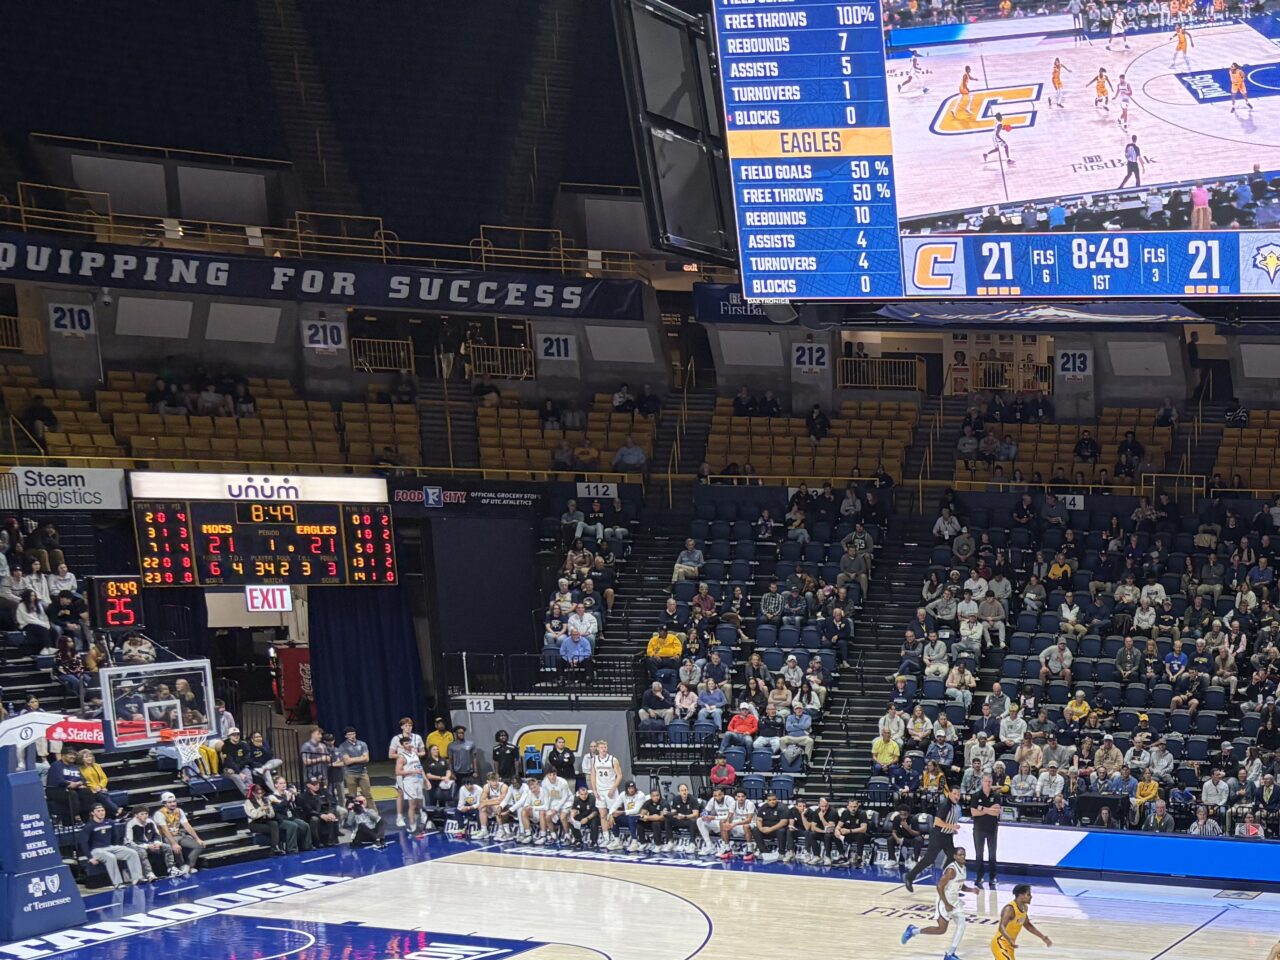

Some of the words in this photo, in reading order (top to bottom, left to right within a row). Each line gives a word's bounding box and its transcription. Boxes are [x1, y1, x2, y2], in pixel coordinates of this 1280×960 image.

[725, 14, 755, 29] FREE
[757, 11, 807, 28] THROWS
[836, 6, 874, 25] 100%
[727, 37, 790, 53] REBOUNDS
[838, 33, 848, 51] 7
[730, 62, 779, 77] ASSISTS
[841, 57, 851, 75] 5
[732, 86, 800, 101] TURNOVERS
[843, 81, 850, 100] 1
[735, 110, 780, 125] BLOCKS
[846, 107, 856, 125] 0
[780, 131, 842, 153] EAGLES
[740, 165, 773, 180] FIELD
[775, 165, 812, 179] GOALS
[743, 189, 772, 203] FREE
[773, 188, 823, 202] THROWS
[745, 211, 807, 226] REBOUNDS
[854, 206, 870, 224] 10
[748, 235, 795, 249] ASSISTS
[857, 231, 867, 248] 4
[750, 257, 817, 271] TURNOVERS
[858, 252, 869, 269] 4
[982, 242, 1014, 281] 21
[1033, 250, 1054, 265] FLS
[1071, 238, 1129, 269] 8:49
[1144, 247, 1165, 263] FLS
[1188, 240, 1220, 279] 21
[1042, 269, 1050, 283] 6
[1092, 275, 1110, 290] 1ST
[1152, 268, 1160, 282] 3
[271, 267, 356, 295] FOR
[388, 275, 583, 309] SUCCESS
[753, 279, 796, 293] BLOCKS
[861, 276, 871, 293] 0
[53, 306, 91, 331] 210
[307, 323, 342, 346] 210
[543, 336, 570, 358] 211
[795, 346, 826, 366] 212
[1060, 352, 1088, 373] 213
[24, 470, 85, 487] Steam
[228, 477, 299, 499] unum
[394, 490, 424, 502] FOOD
[443, 491, 467, 504] CITY
[584, 484, 610, 497] 112
[25, 488, 102, 509] Logistics
[251, 504, 294, 522] 8:49
[202, 525, 233, 534] MOCS
[296, 525, 337, 535] EAGLES
[209, 536, 235, 554] 21
[270, 539, 275, 551] 1
[311, 536, 335, 554] 21
[210, 562, 221, 576] 6
[232, 562, 243, 575] 4
[255, 561, 275, 576] 34
[280, 561, 290, 576] 2
[301, 562, 312, 576] 3
[327, 562, 337, 576] 3
[108, 581, 138, 596] 8:49
[249, 587, 288, 610] EXIT
[107, 598, 135, 625] 25
[468, 700, 492, 712] 112
[26, 840, 48, 850] HERE
[21, 850, 38, 860] FOR
[23, 902, 33, 912] of
[33, 896, 72, 910] Tennessee
